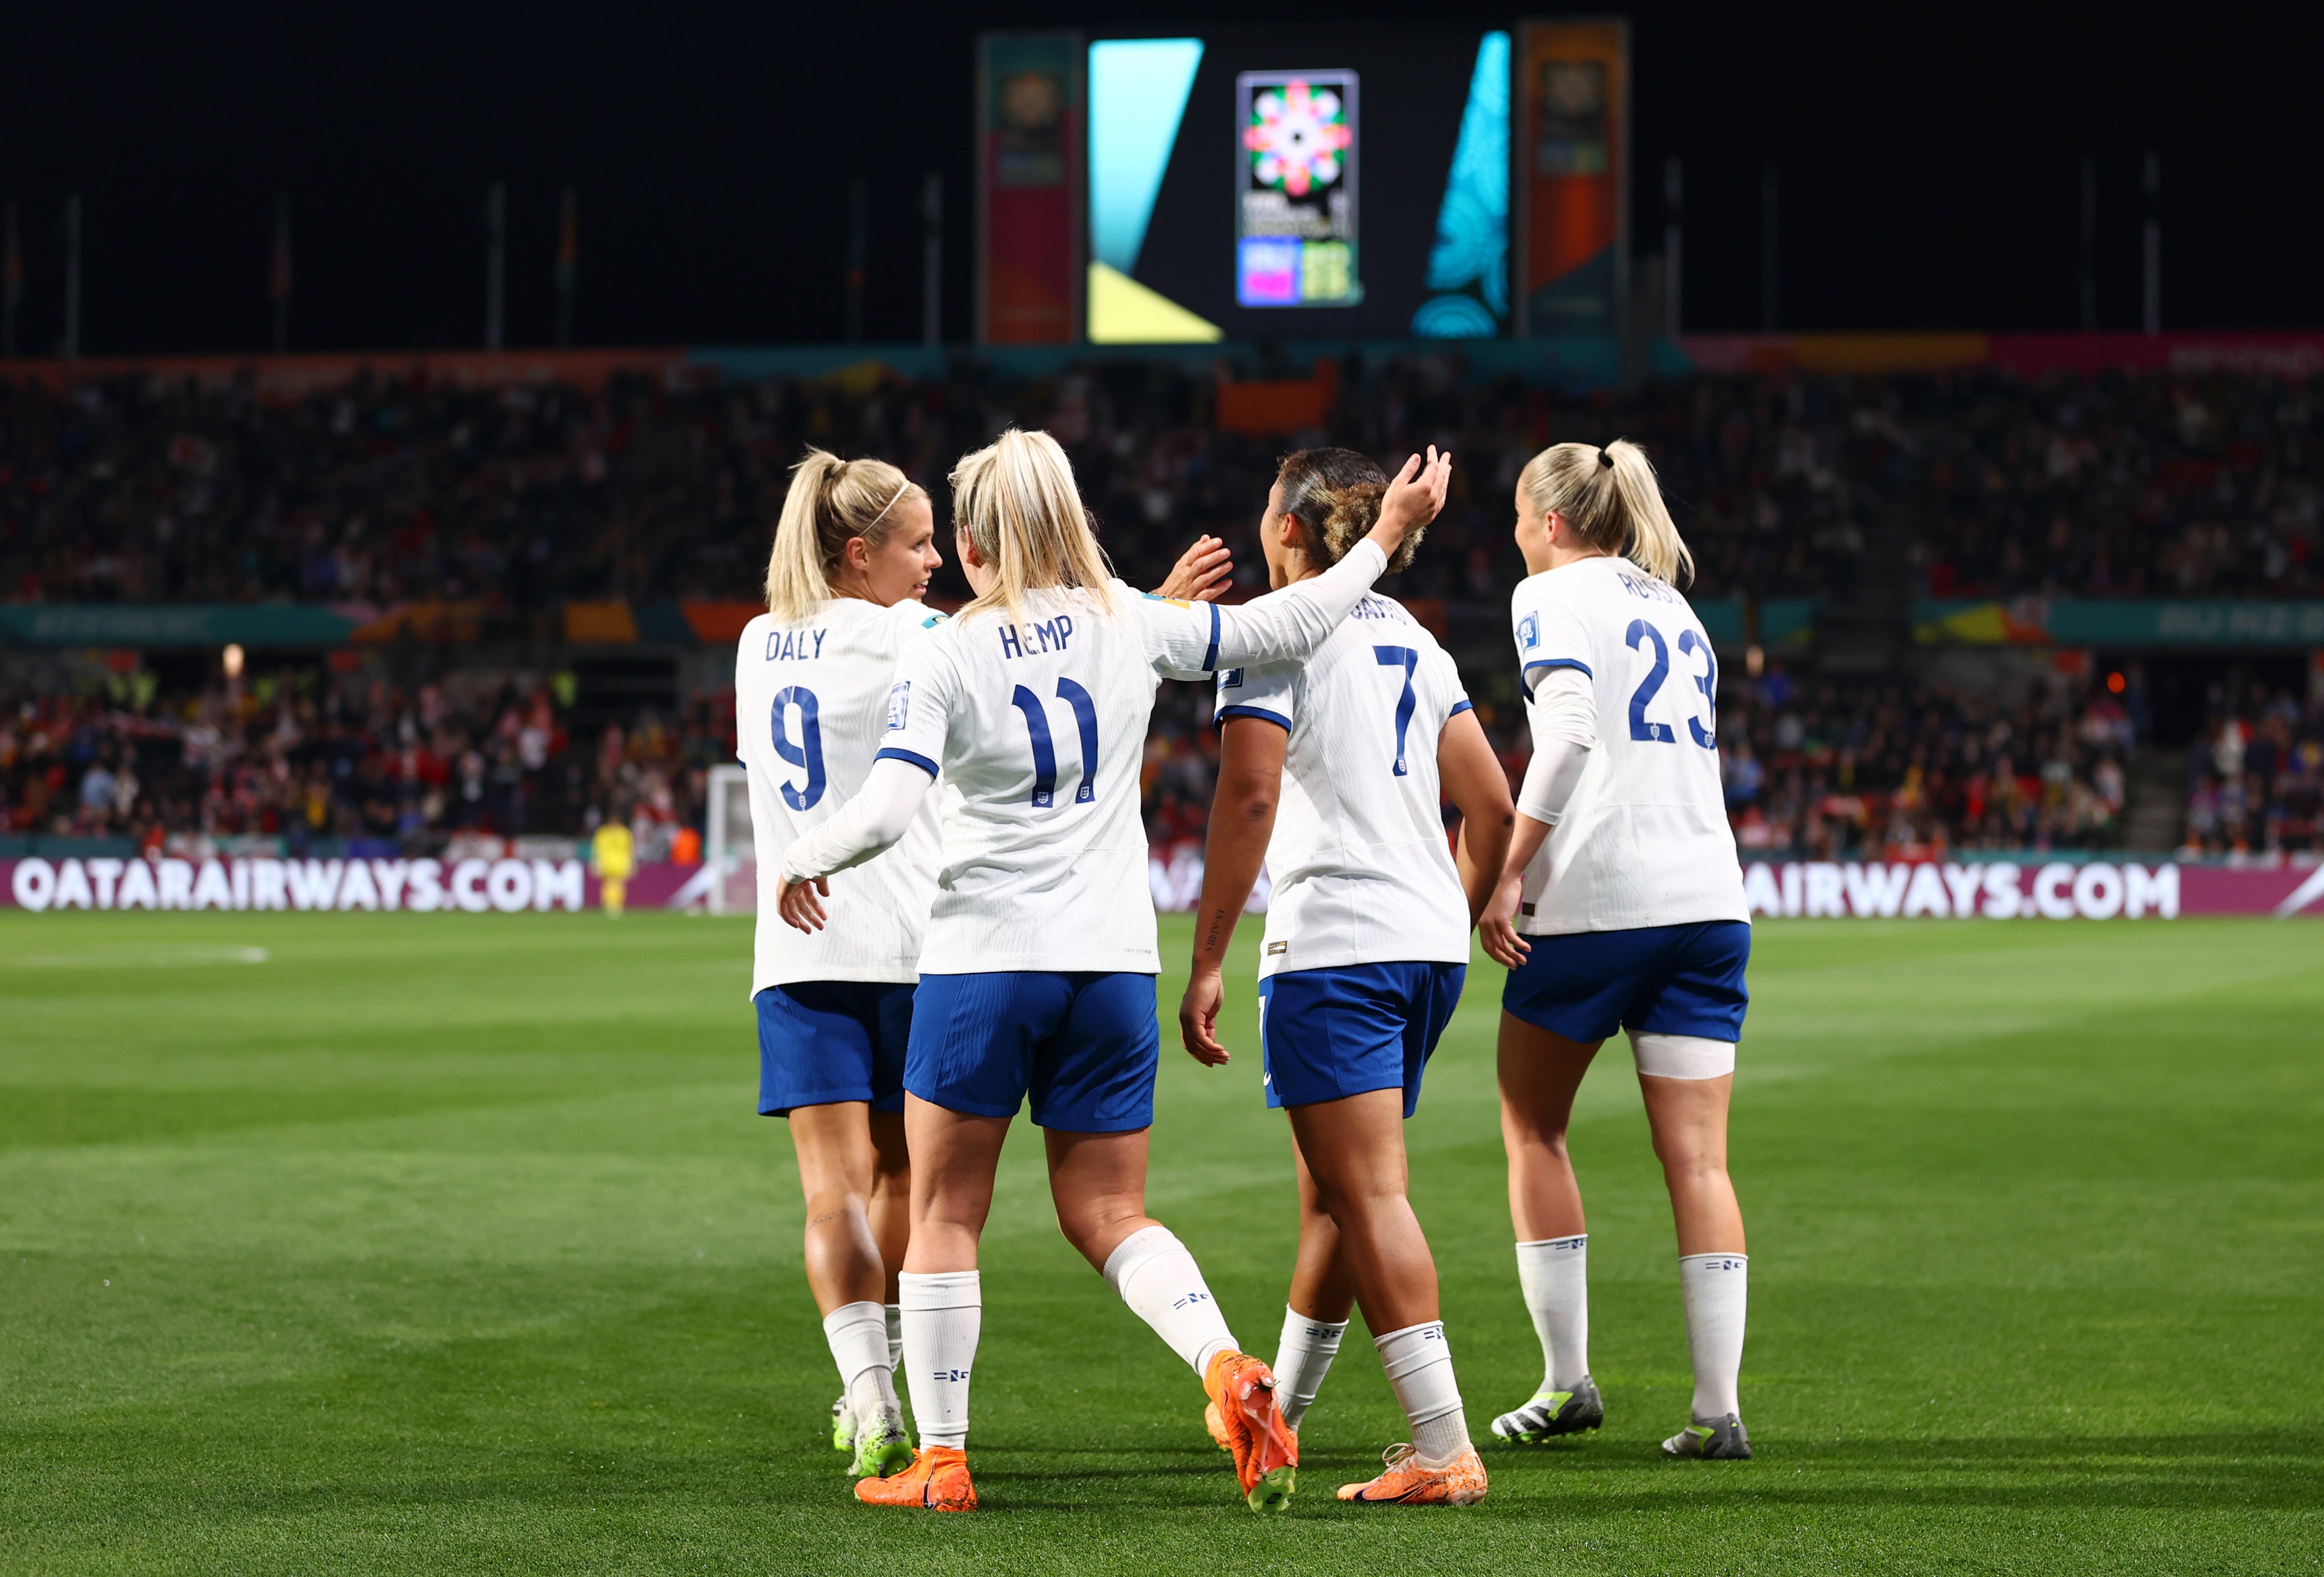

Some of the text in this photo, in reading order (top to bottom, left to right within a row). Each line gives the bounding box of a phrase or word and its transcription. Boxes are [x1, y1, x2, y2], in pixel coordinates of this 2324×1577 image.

[766, 628, 827, 661] DALY
[999, 615, 1073, 659] HEMP
[1372, 645, 1418, 776] 7
[1626, 618, 1717, 750] 23
[771, 685, 826, 811] 9
[1012, 677, 1098, 808] 11
[12, 857, 586, 912] QATARAIRWAYS.COM
[1742, 862, 2181, 920] AIRWAYS.COM
